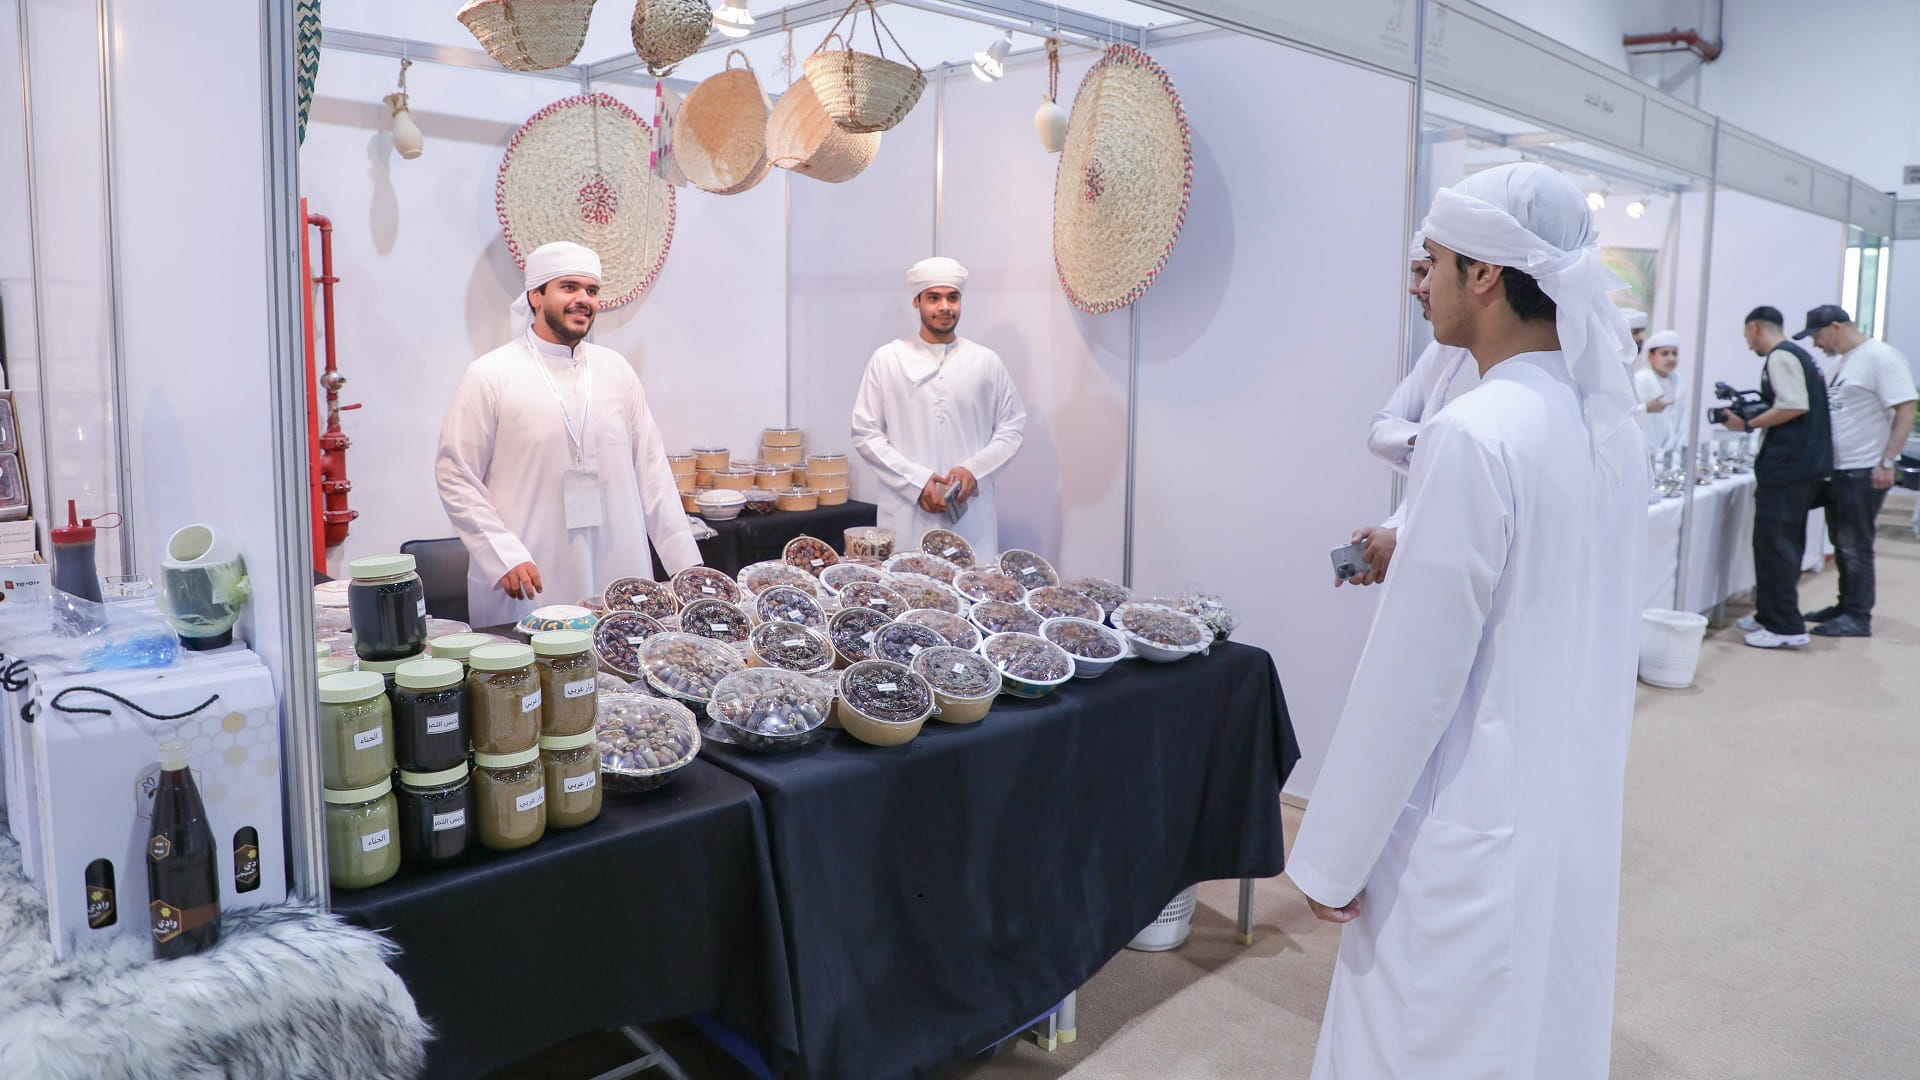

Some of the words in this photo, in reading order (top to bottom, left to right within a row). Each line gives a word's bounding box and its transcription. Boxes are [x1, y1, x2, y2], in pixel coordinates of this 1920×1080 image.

[567, 686, 584, 695] عربي
[428, 720, 443, 729] التمر
[360, 732, 378, 744] الحناء
[567, 781, 585, 790] عربي
[519, 798, 536, 808] عربي
[434, 818, 449, 827] التمر
[367, 833, 386, 847] الحناء
